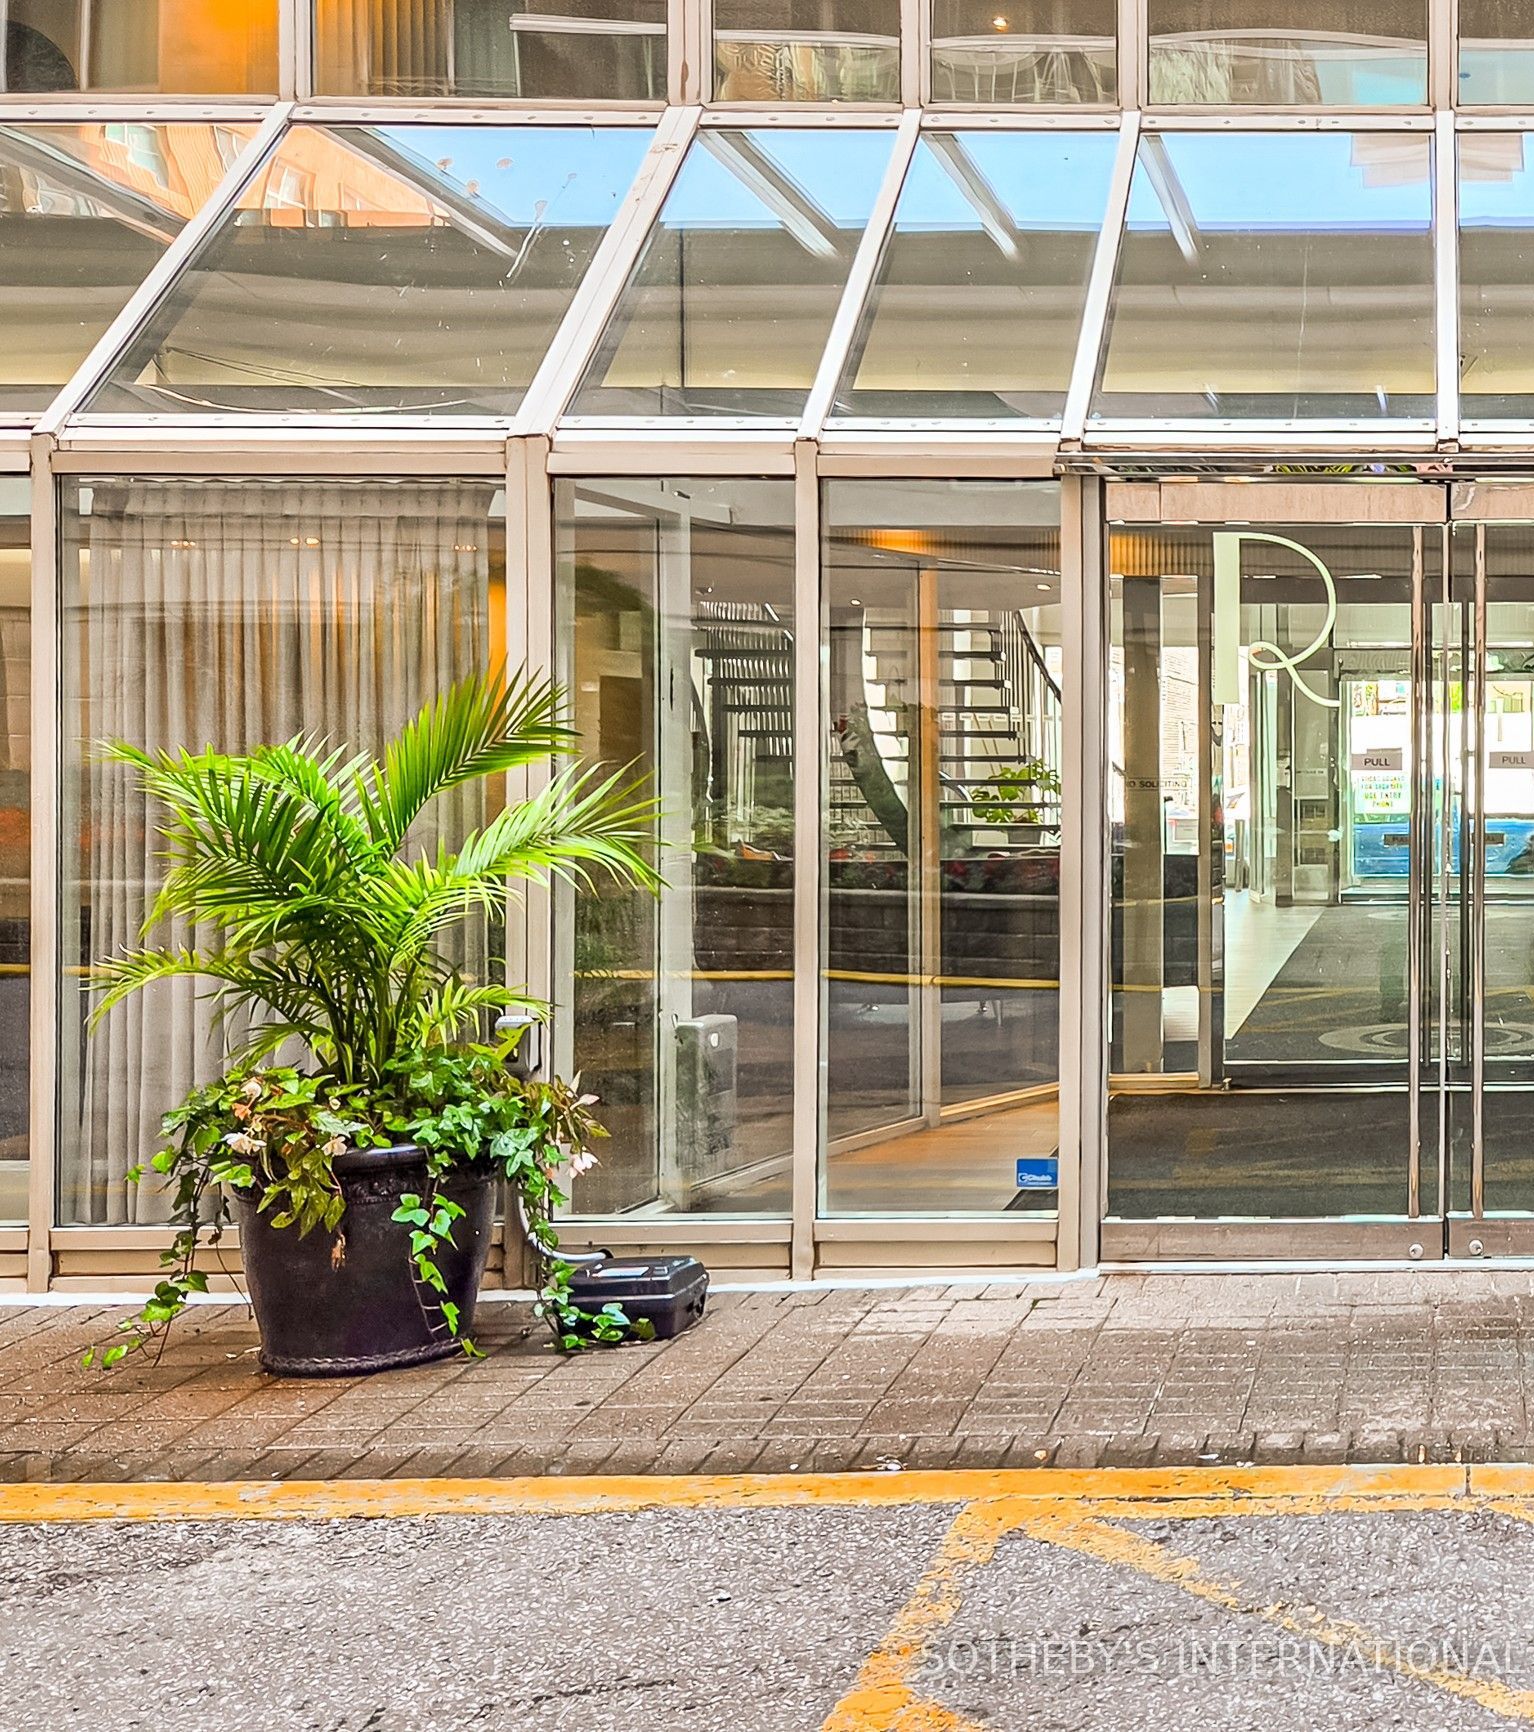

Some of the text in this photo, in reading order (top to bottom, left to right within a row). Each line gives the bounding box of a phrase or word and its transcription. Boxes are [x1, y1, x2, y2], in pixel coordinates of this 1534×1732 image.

[1213, 531, 1341, 707] R
[1364, 757, 1391, 767] PULL
[1501, 755, 1526, 765] PULL
